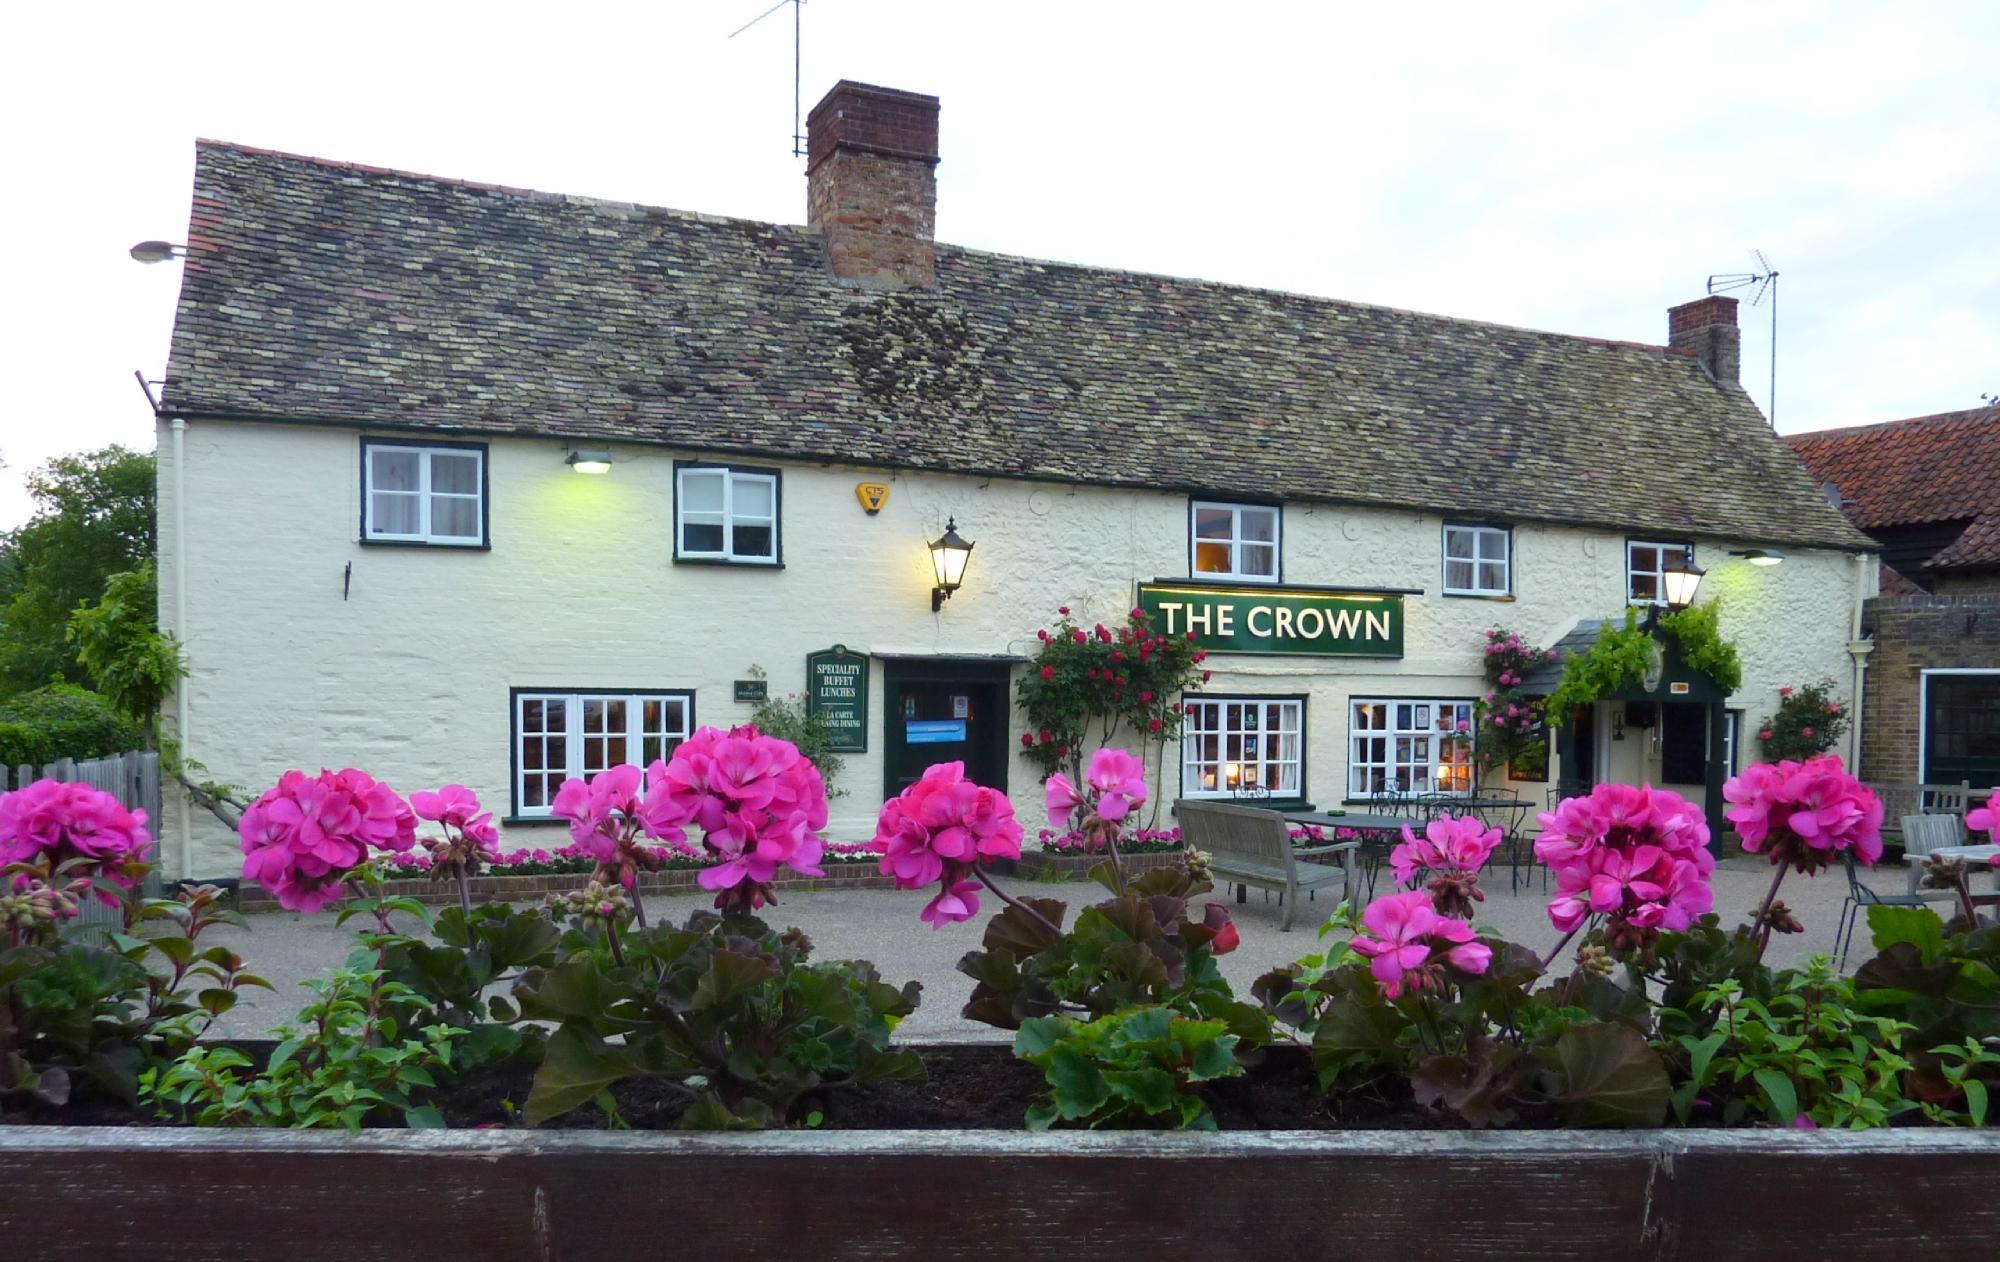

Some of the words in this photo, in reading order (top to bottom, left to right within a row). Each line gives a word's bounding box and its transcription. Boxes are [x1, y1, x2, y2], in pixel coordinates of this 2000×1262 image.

[1159, 602, 1235, 636] THE
[1247, 606, 1390, 641] CROWN
[817, 664, 861, 675] SPECIALITY
[824, 675, 854, 686] BUFFET
[820, 687, 856, 697] LUNCHES
[834, 711, 854, 719] CARTE
[840, 719, 861, 728] DINING
